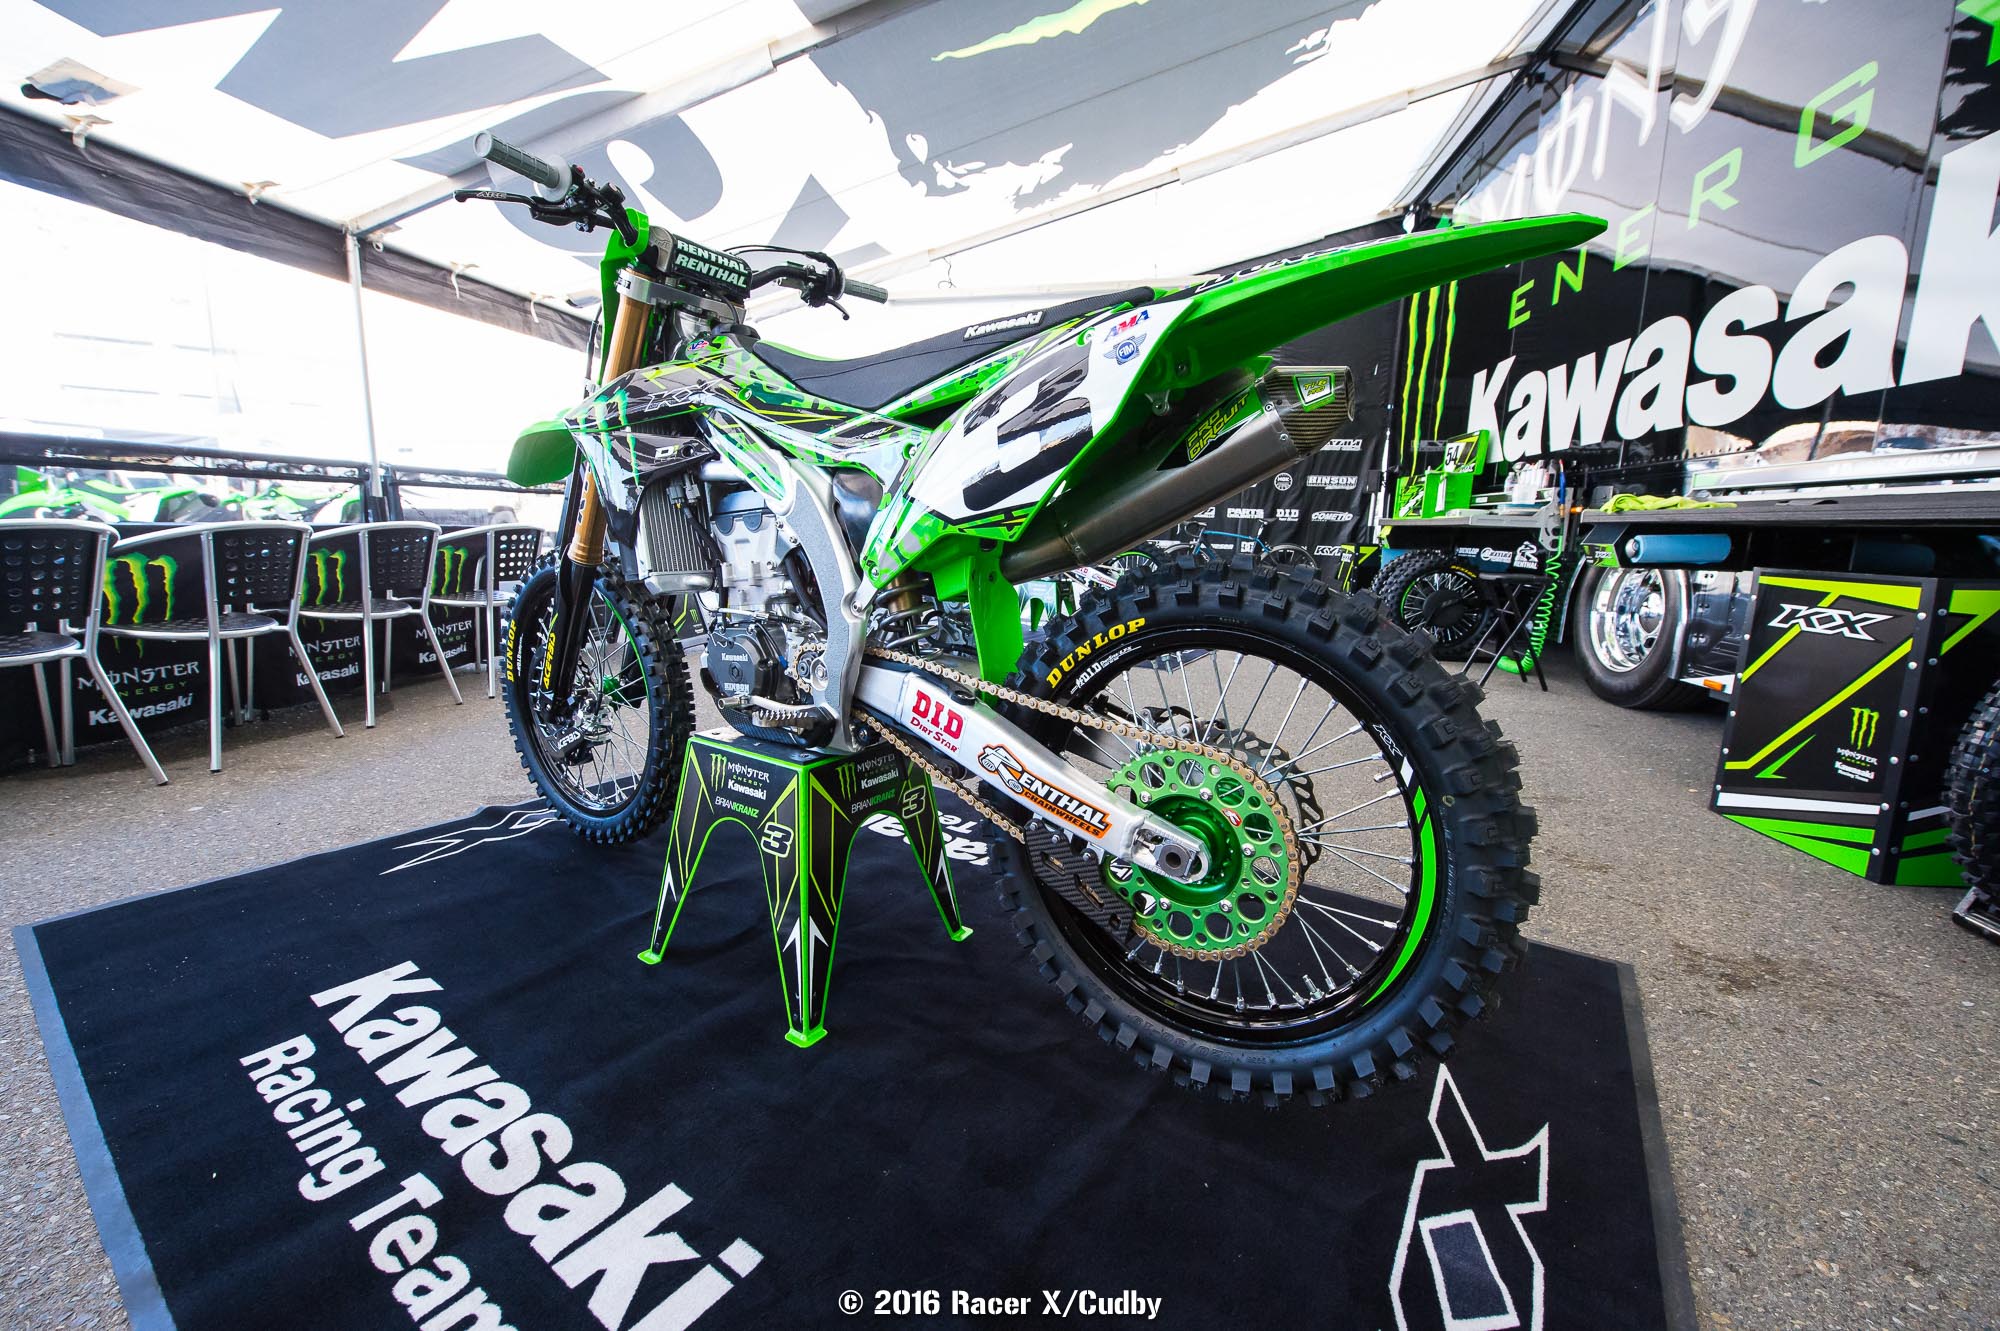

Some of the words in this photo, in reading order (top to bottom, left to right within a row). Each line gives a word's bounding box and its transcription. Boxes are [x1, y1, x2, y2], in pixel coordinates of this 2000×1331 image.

[675, 253, 747, 288] RENTHAL
[677, 239, 749, 274] RENTHAL
[965, 311, 1043, 339] Kawasaki
[1104, 309, 1150, 342] AMA
[1118, 343, 1136, 357] FIM
[1187, 409, 1220, 447] PRO
[1189, 393, 1249, 459] CIRCUIT
[1446, 445, 1460, 466] 54
[1309, 476, 1357, 486] HINSON
[1768, 603, 1894, 641] KX
[289, 635, 361, 657] MNSTER
[506, 619, 516, 682] DUNLOP
[721, 652, 749, 662] Kawasaki
[1046, 618, 1145, 689] DUNLOP
[102, 681, 187, 700] NERGY
[912, 689, 965, 740] D.I.D
[728, 762, 770, 783] MONSTER
[728, 778, 767, 801] Kawasaki
[861, 767, 900, 790] Kawasaki
[979, 745, 1108, 828] RENTHAL
[903, 785, 926, 820] 3
[1022, 790, 1101, 836] CHAINWHEELS
[761, 821, 795, 859] 3
[239, 1034, 386, 1202] Racing
[310, 960, 764, 1331] Kawasaki
